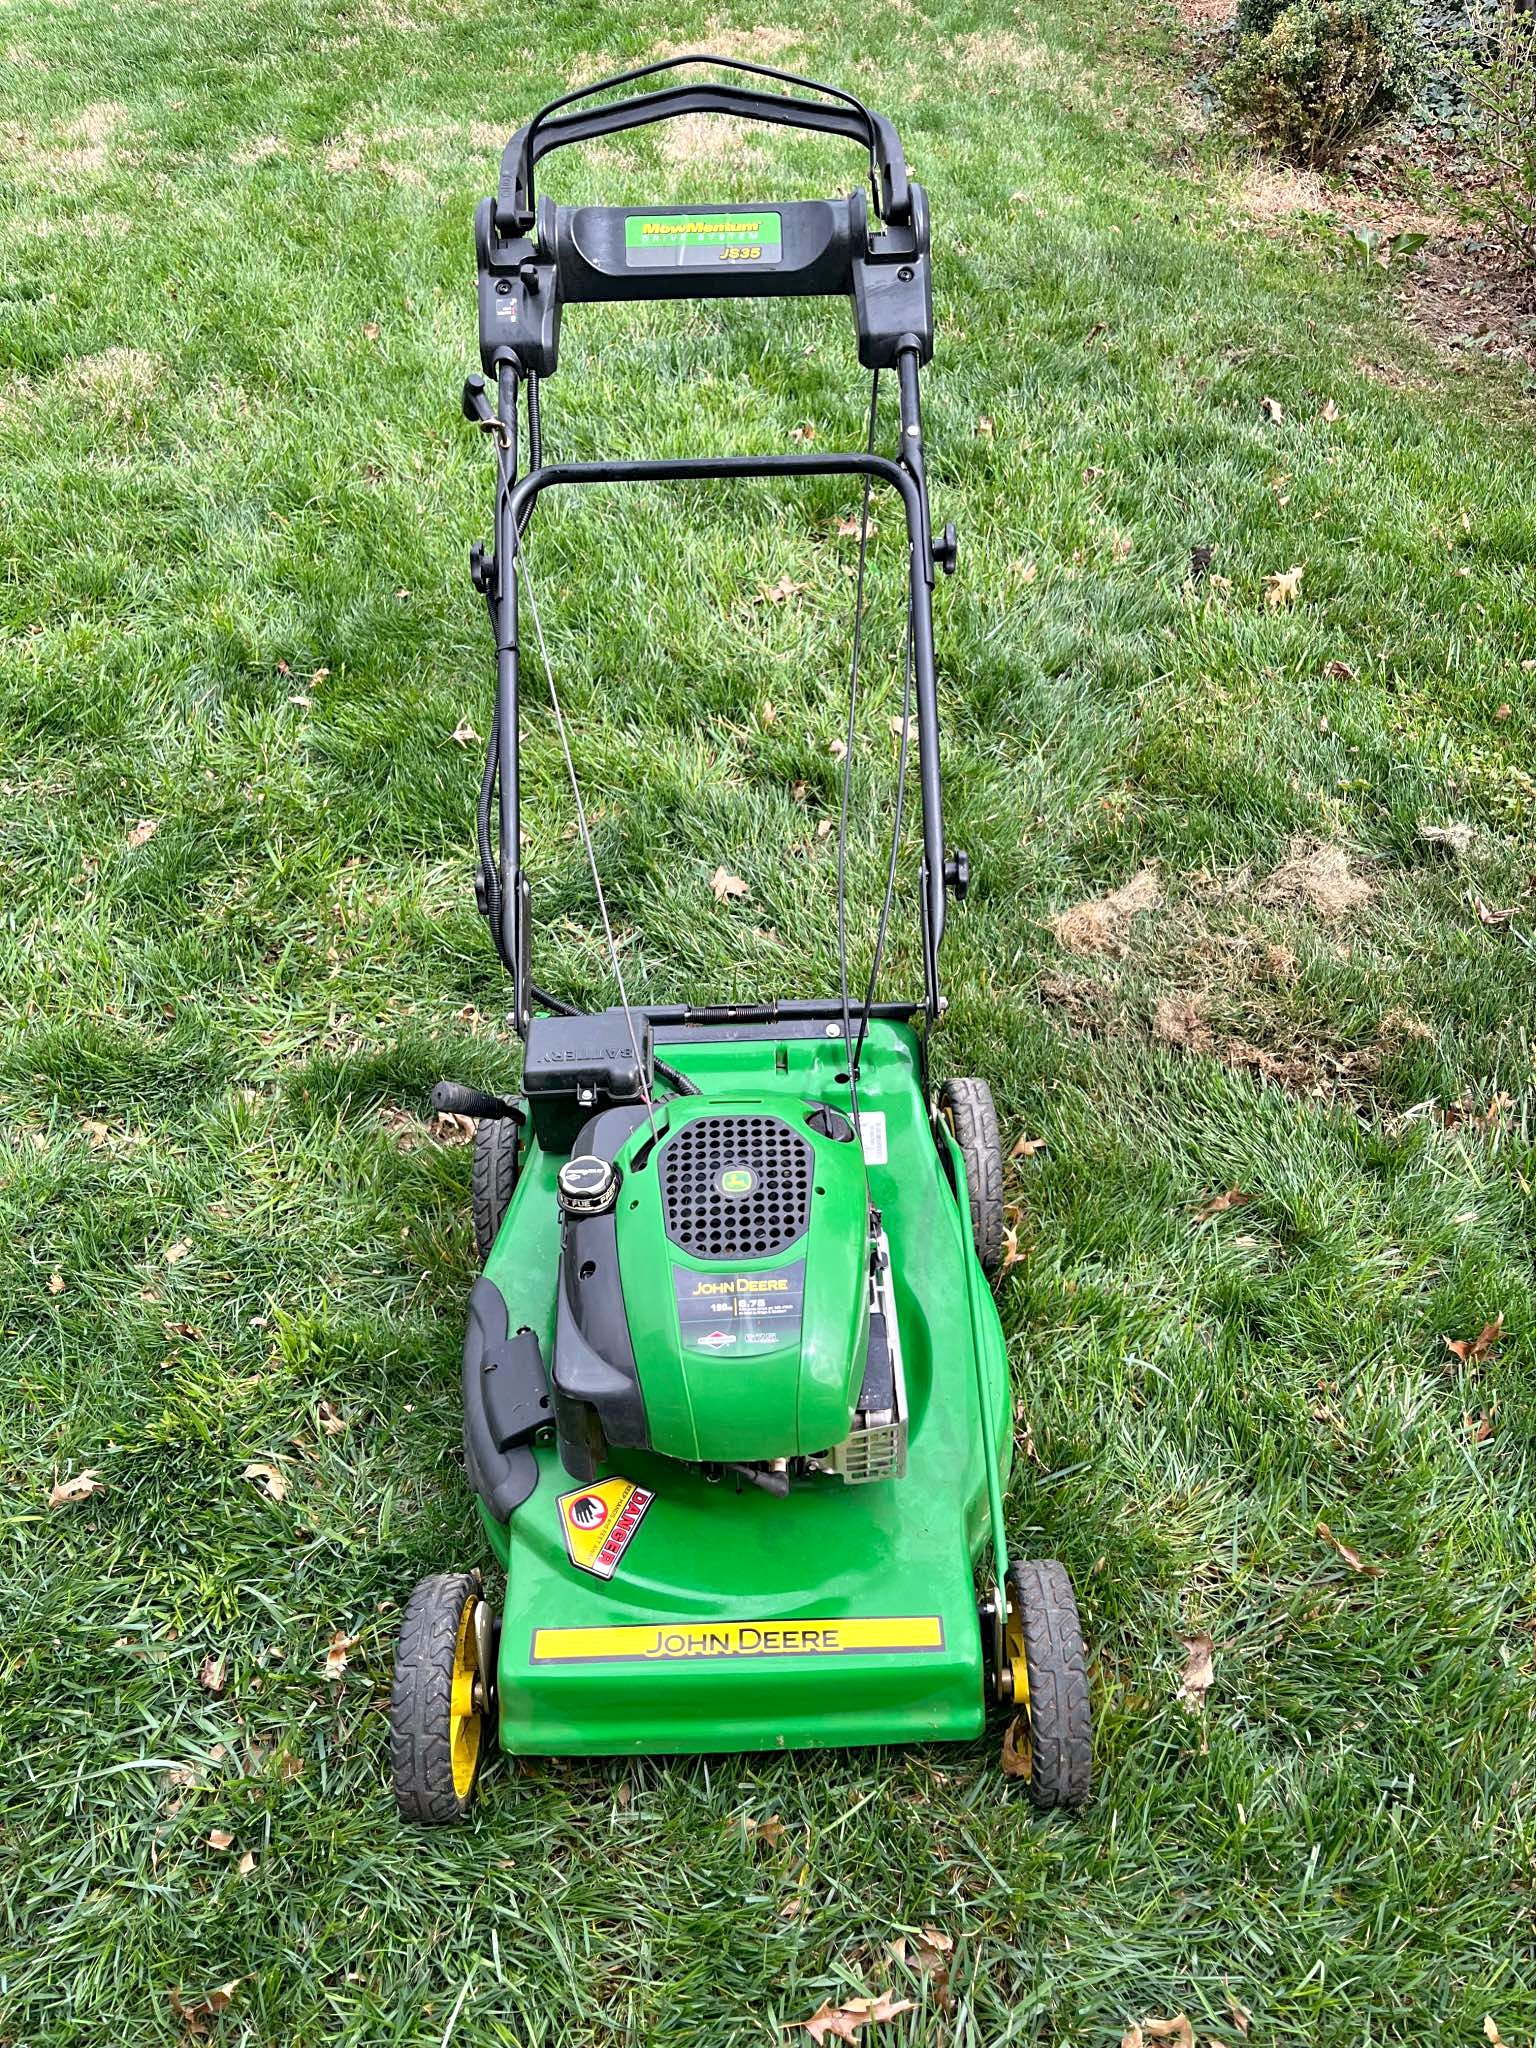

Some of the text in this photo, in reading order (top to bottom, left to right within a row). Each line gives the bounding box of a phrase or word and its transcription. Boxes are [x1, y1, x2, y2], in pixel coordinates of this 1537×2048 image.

[719, 246, 762, 260] JS35
[537, 1047, 635, 1063] BATTERY
[692, 1278, 789, 1296] JOHN DEERE
[597, 1490, 649, 1567] DANGER
[647, 1628, 840, 1654] JOHN DEERE
